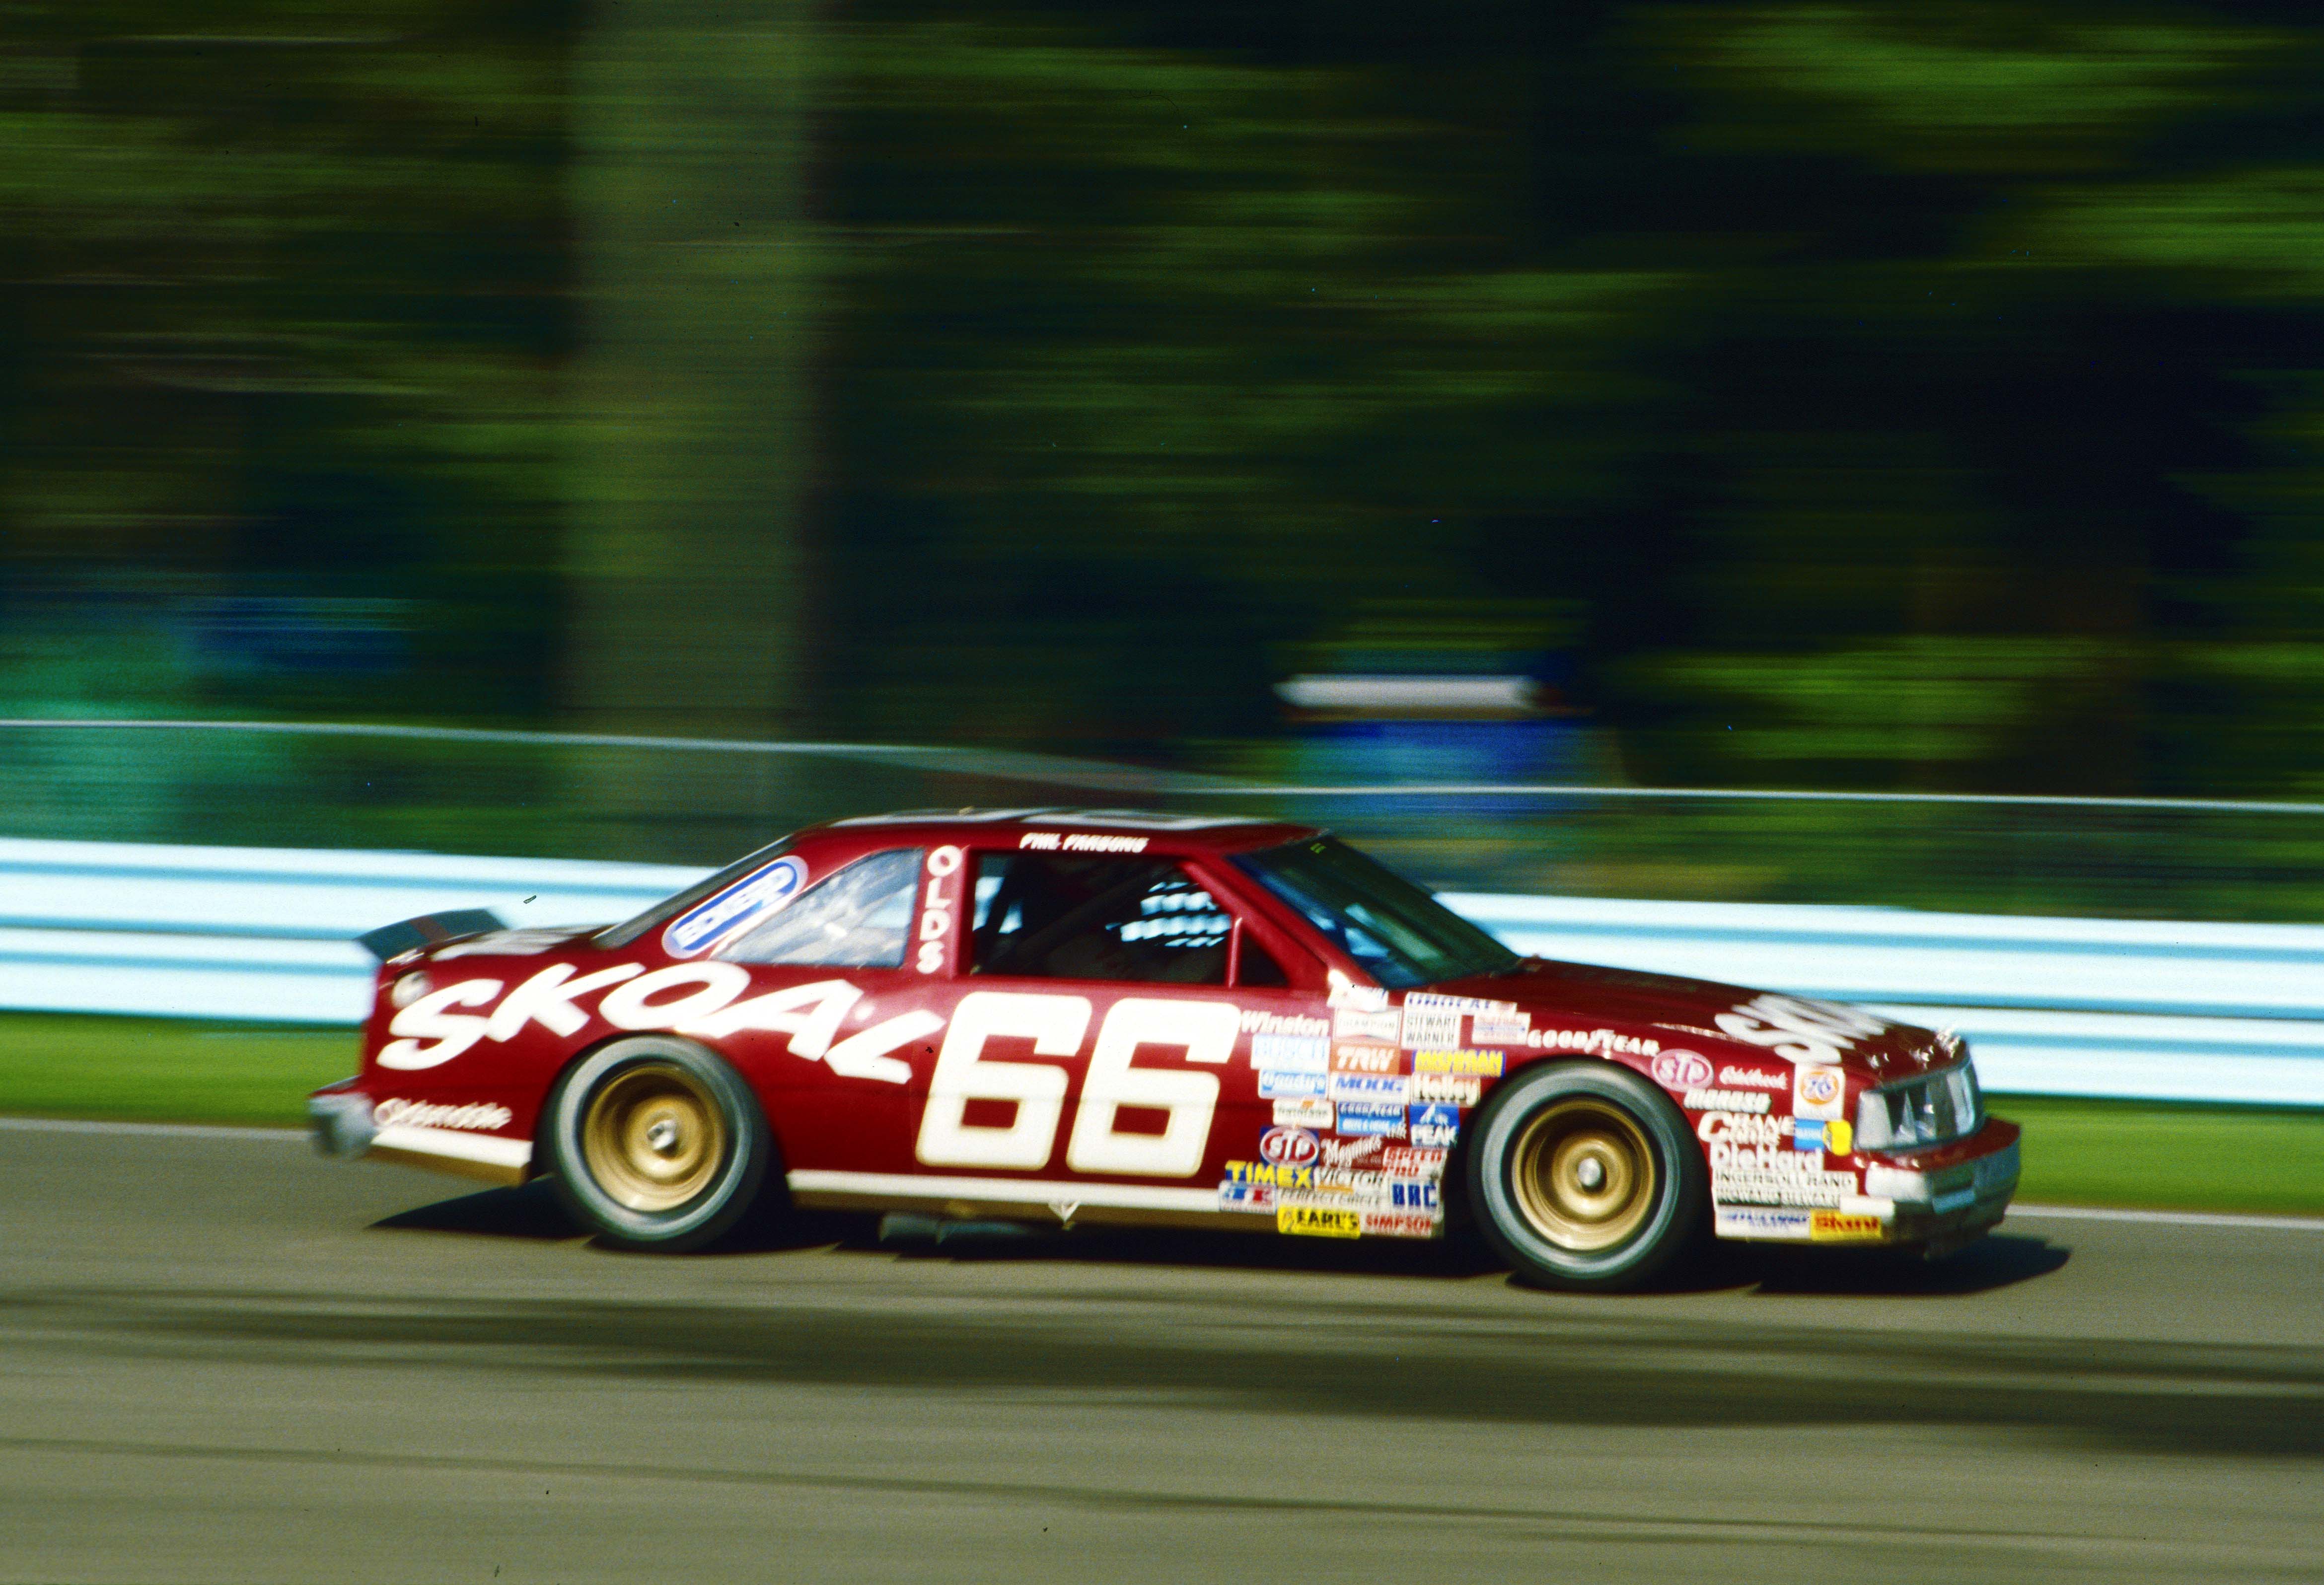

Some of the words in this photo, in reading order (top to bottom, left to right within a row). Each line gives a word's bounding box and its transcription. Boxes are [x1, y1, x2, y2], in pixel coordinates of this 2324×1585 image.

[916, 845, 962, 974] OLDS
[376, 962, 944, 1084] SKOAL
[1241, 1009, 1330, 1037] Winston
[1527, 1029, 1660, 1056] GOODYEAR
[1336, 1046, 1394, 1071] TRW
[1659, 1053, 1705, 1084] STP
[915, 992, 1241, 1179] 66
[1269, 1130, 1310, 1159] STP
[1225, 1160, 1313, 1189] TIMEX
